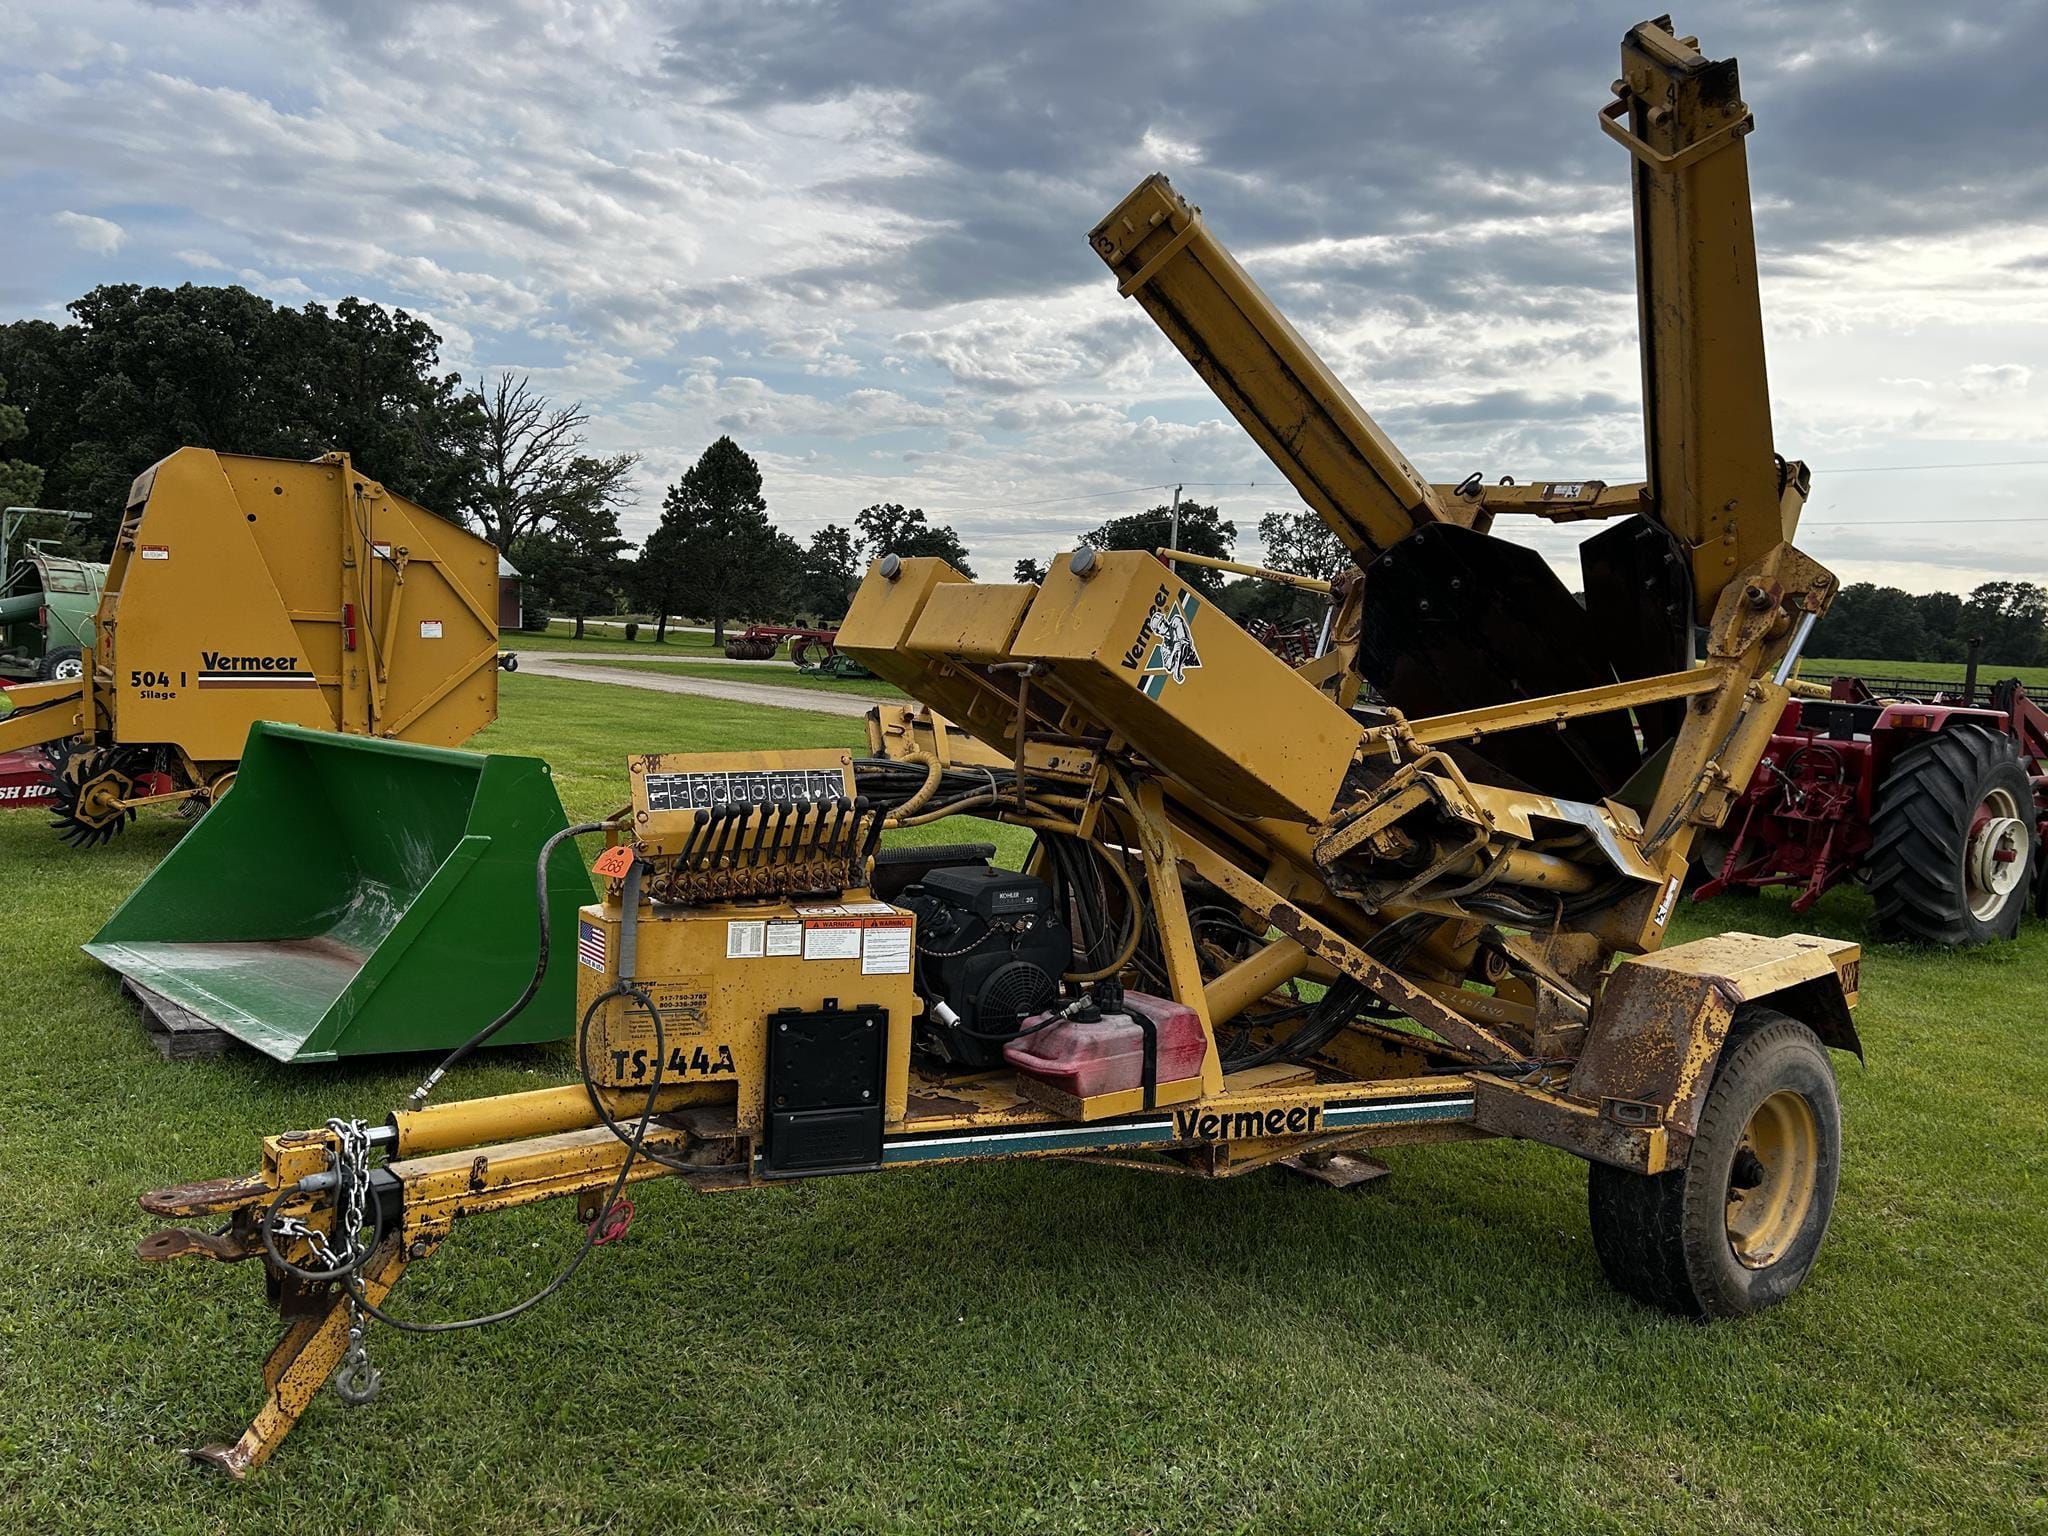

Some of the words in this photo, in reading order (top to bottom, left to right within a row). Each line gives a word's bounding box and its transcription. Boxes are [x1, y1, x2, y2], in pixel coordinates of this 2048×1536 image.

[1099, 236, 1115, 254] 3
[202, 652, 298, 671] Vermeer
[130, 671, 170, 688] 504
[140, 690, 177, 701] Silage
[23, 785, 57, 798] HO
[600, 858, 625, 873] 268
[999, 891, 1020, 899] KOHLER
[879, 919, 906, 927] WARNING
[610, 1045, 737, 1080] TS-44A
[1176, 1106, 1321, 1140] Vermeer
